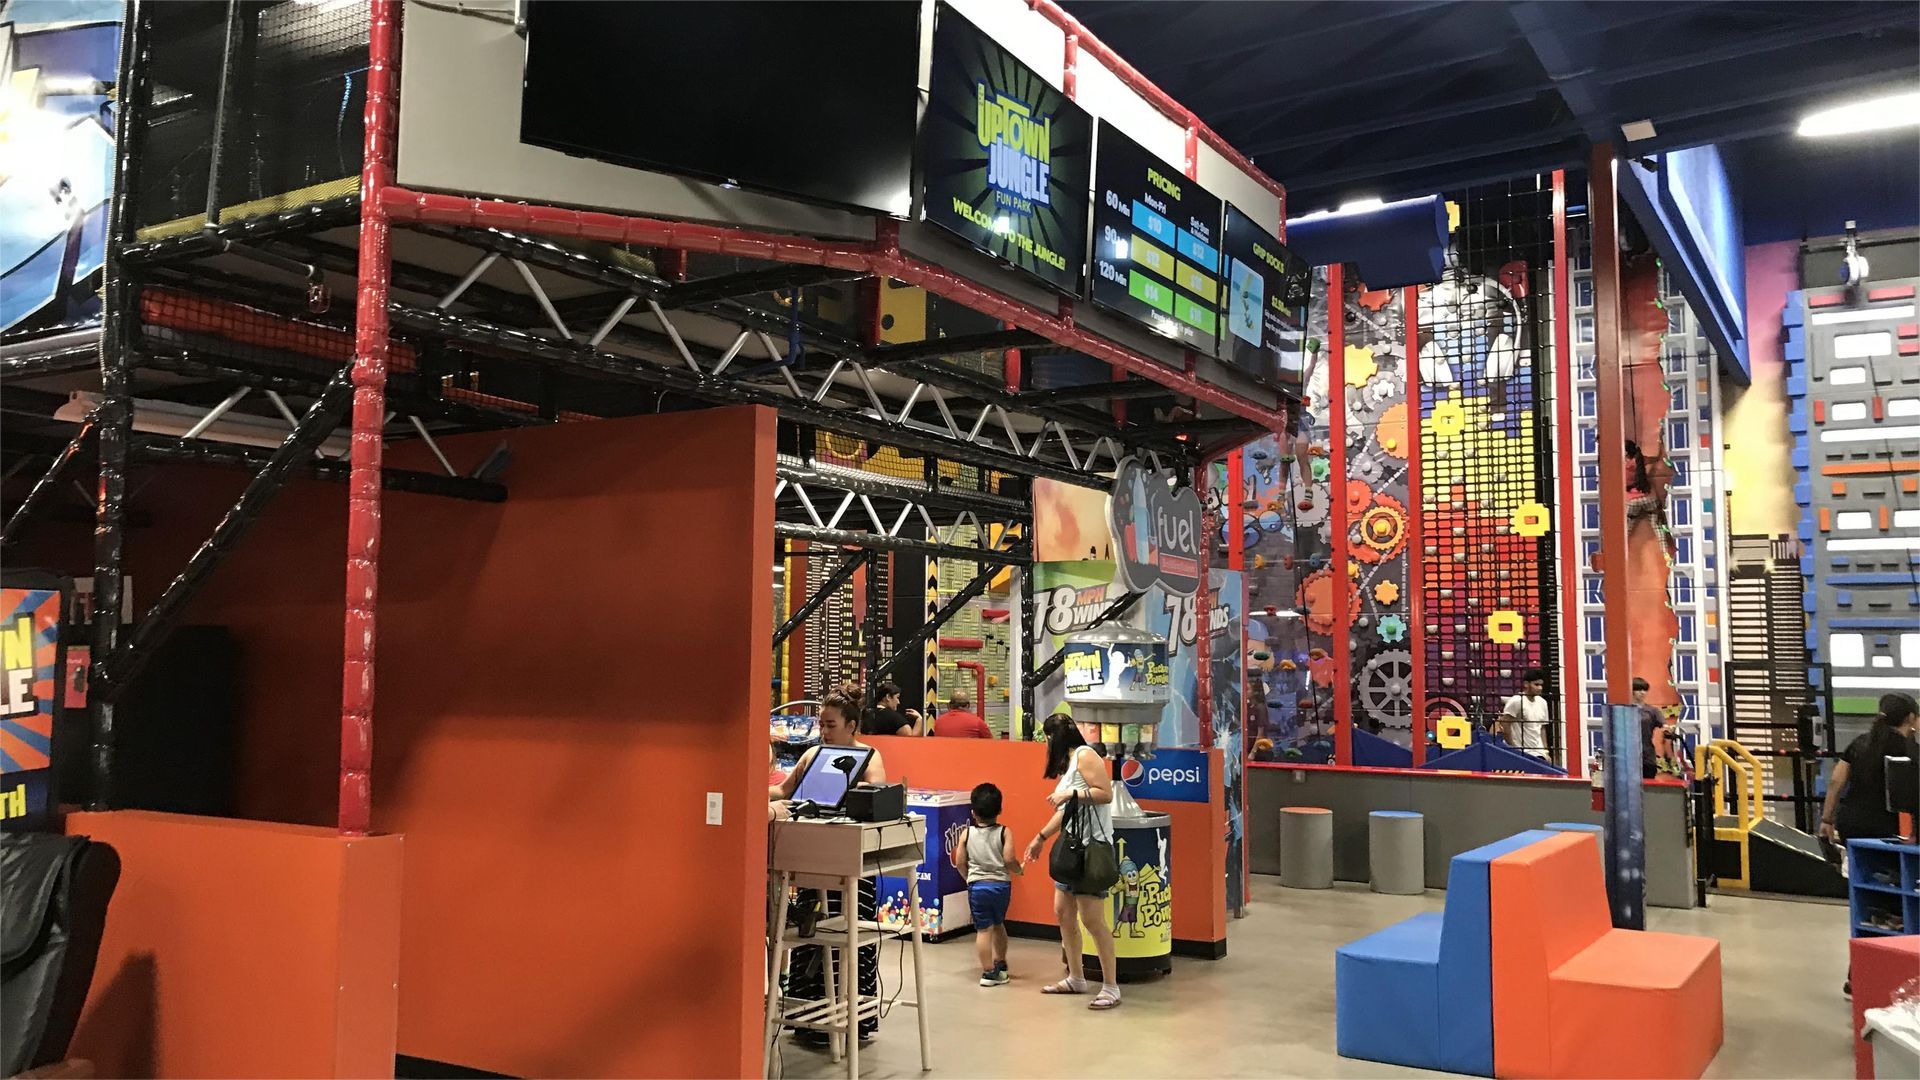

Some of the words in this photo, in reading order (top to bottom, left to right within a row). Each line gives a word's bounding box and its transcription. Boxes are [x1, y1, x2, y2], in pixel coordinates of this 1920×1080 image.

[977, 83, 1050, 164] UPTOWN
[988, 136, 1050, 204] JUNGLE
[1147, 167, 1181, 201] PRICING
[996, 191, 1012, 207] FUN
[1013, 197, 1032, 214] PARK
[1106, 190, 1118, 210] 60
[1017, 233, 1034, 253] THE
[1104, 225, 1117, 245] 90
[1099, 260, 1115, 281] 120
[1157, 506, 1197, 555] fuel
[1033, 586, 1076, 641] 78
[1073, 601, 1114, 625] WIN
[1165, 594, 1197, 652] 78
[1148, 766, 1200, 785] pepsi
